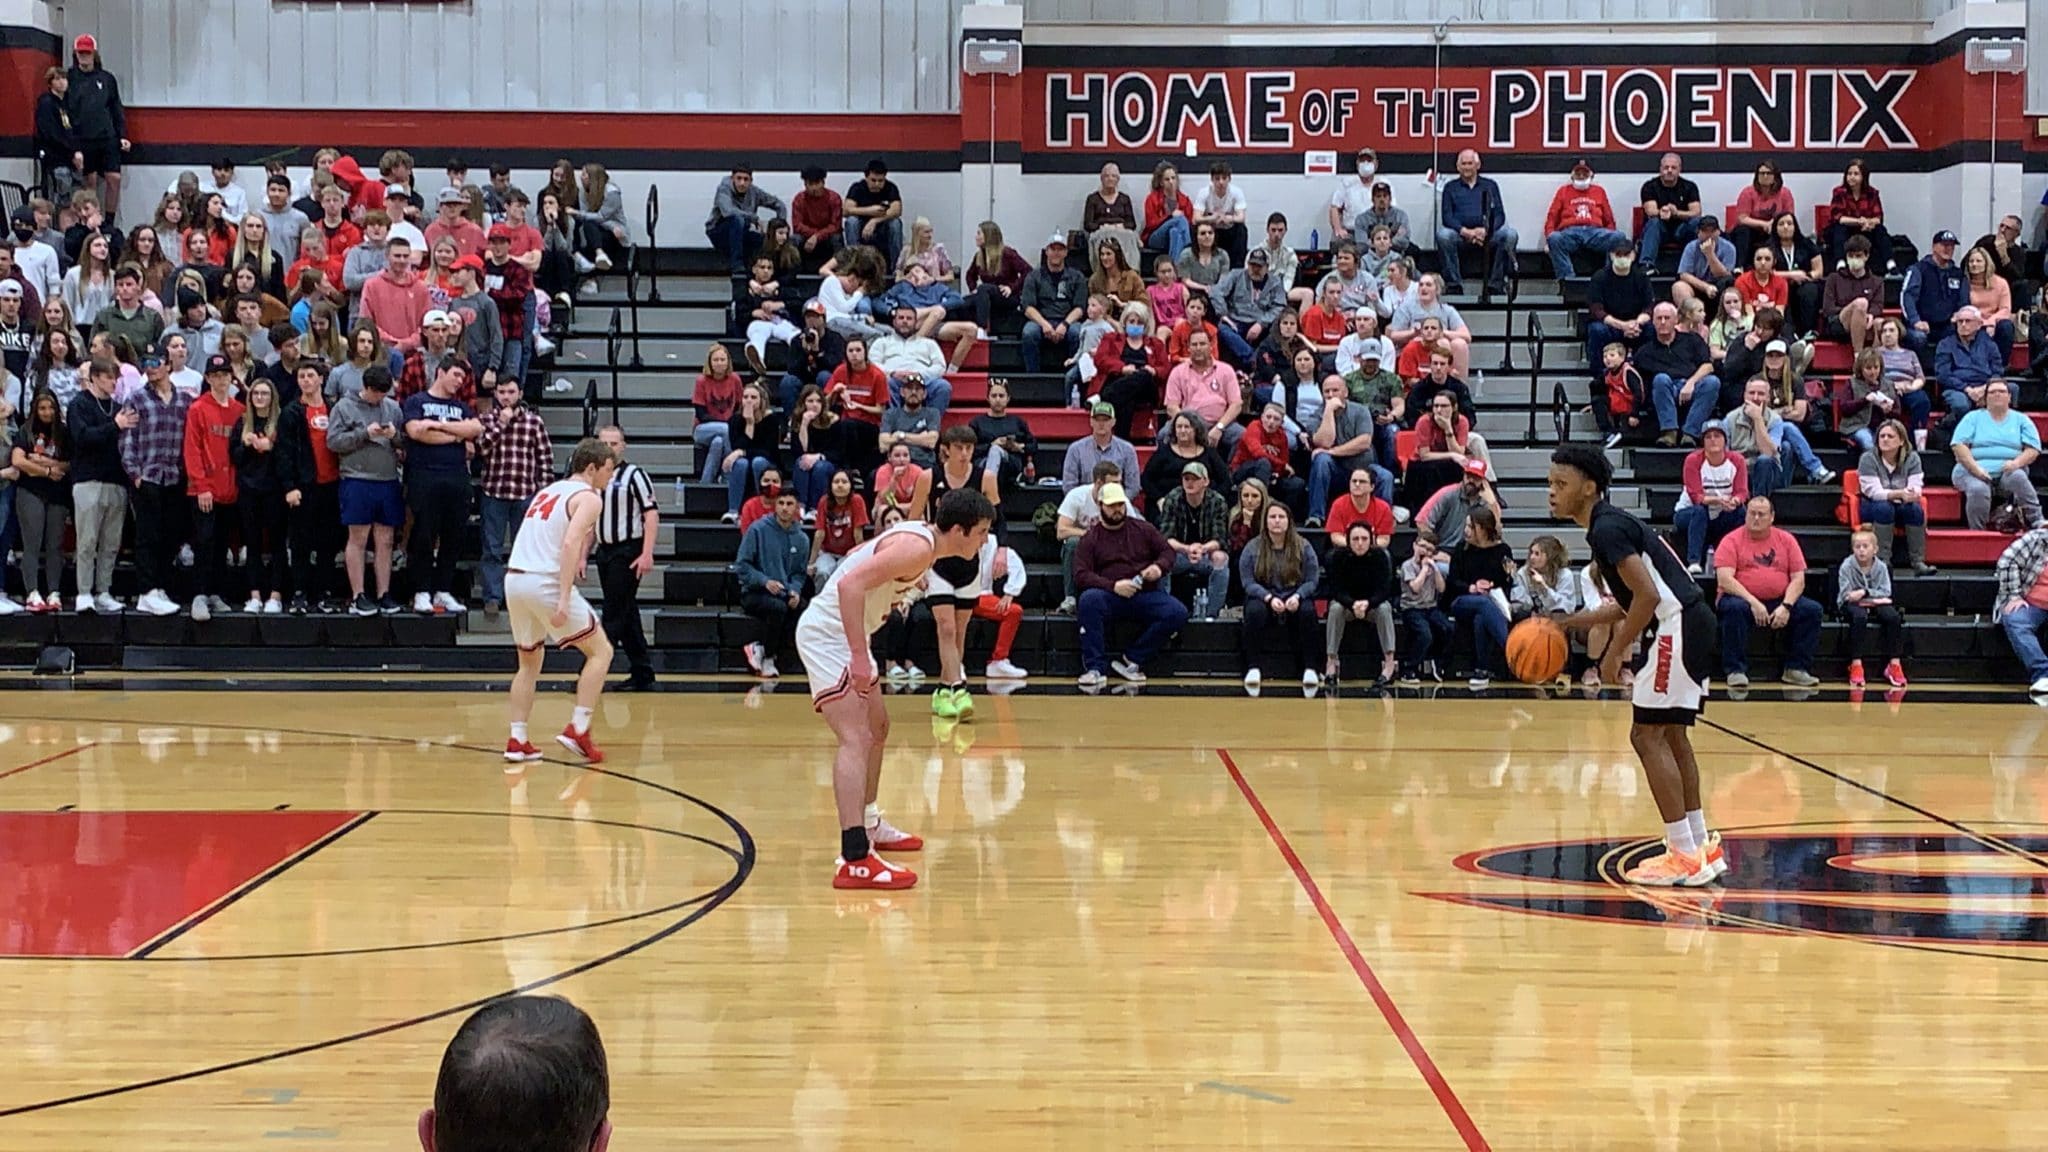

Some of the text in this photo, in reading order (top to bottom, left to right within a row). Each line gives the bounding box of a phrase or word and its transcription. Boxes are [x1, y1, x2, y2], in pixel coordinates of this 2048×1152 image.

[1046, 68, 1918, 150] HOME OF THE PHOENIX
[527, 493, 561, 521] 24
[848, 864, 871, 879] 10
